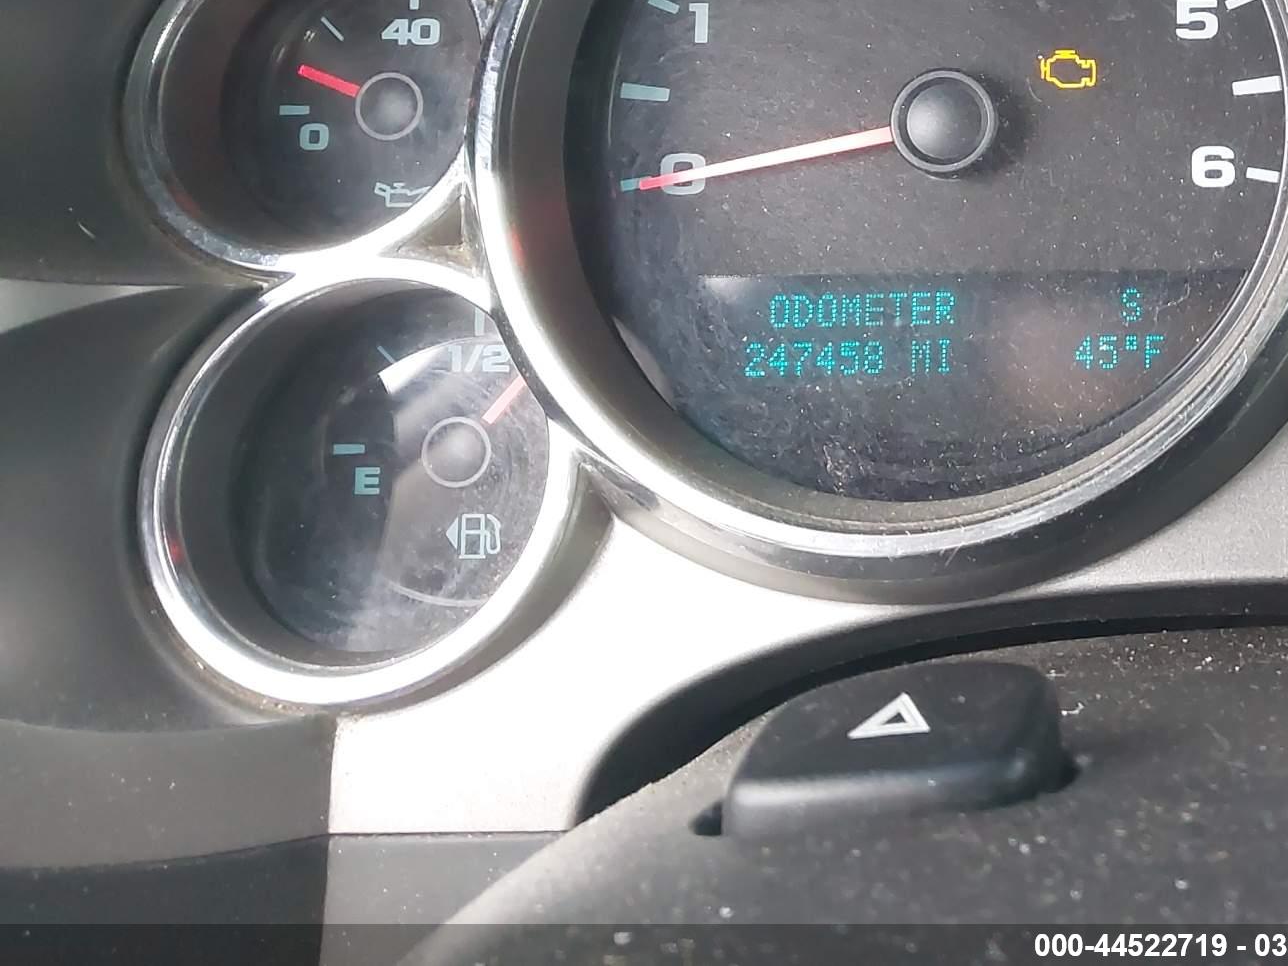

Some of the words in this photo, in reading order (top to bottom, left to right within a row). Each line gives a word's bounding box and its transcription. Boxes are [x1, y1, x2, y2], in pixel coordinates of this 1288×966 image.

[381, 18, 441, 45] 40
[688, 1, 709, 43] 1
[1175, 0, 1220, 40] 5
[299, 123, 329, 151] 0
[659, 152, 706, 196] 0
[1191, 145, 1236, 187] 6
[769, 291, 956, 329] ODOMETER
[448, 345, 511, 373] 1/2
[744, 340, 884, 378] 247458
[911, 338, 952, 376] MI
[354, 466, 381, 495] E
